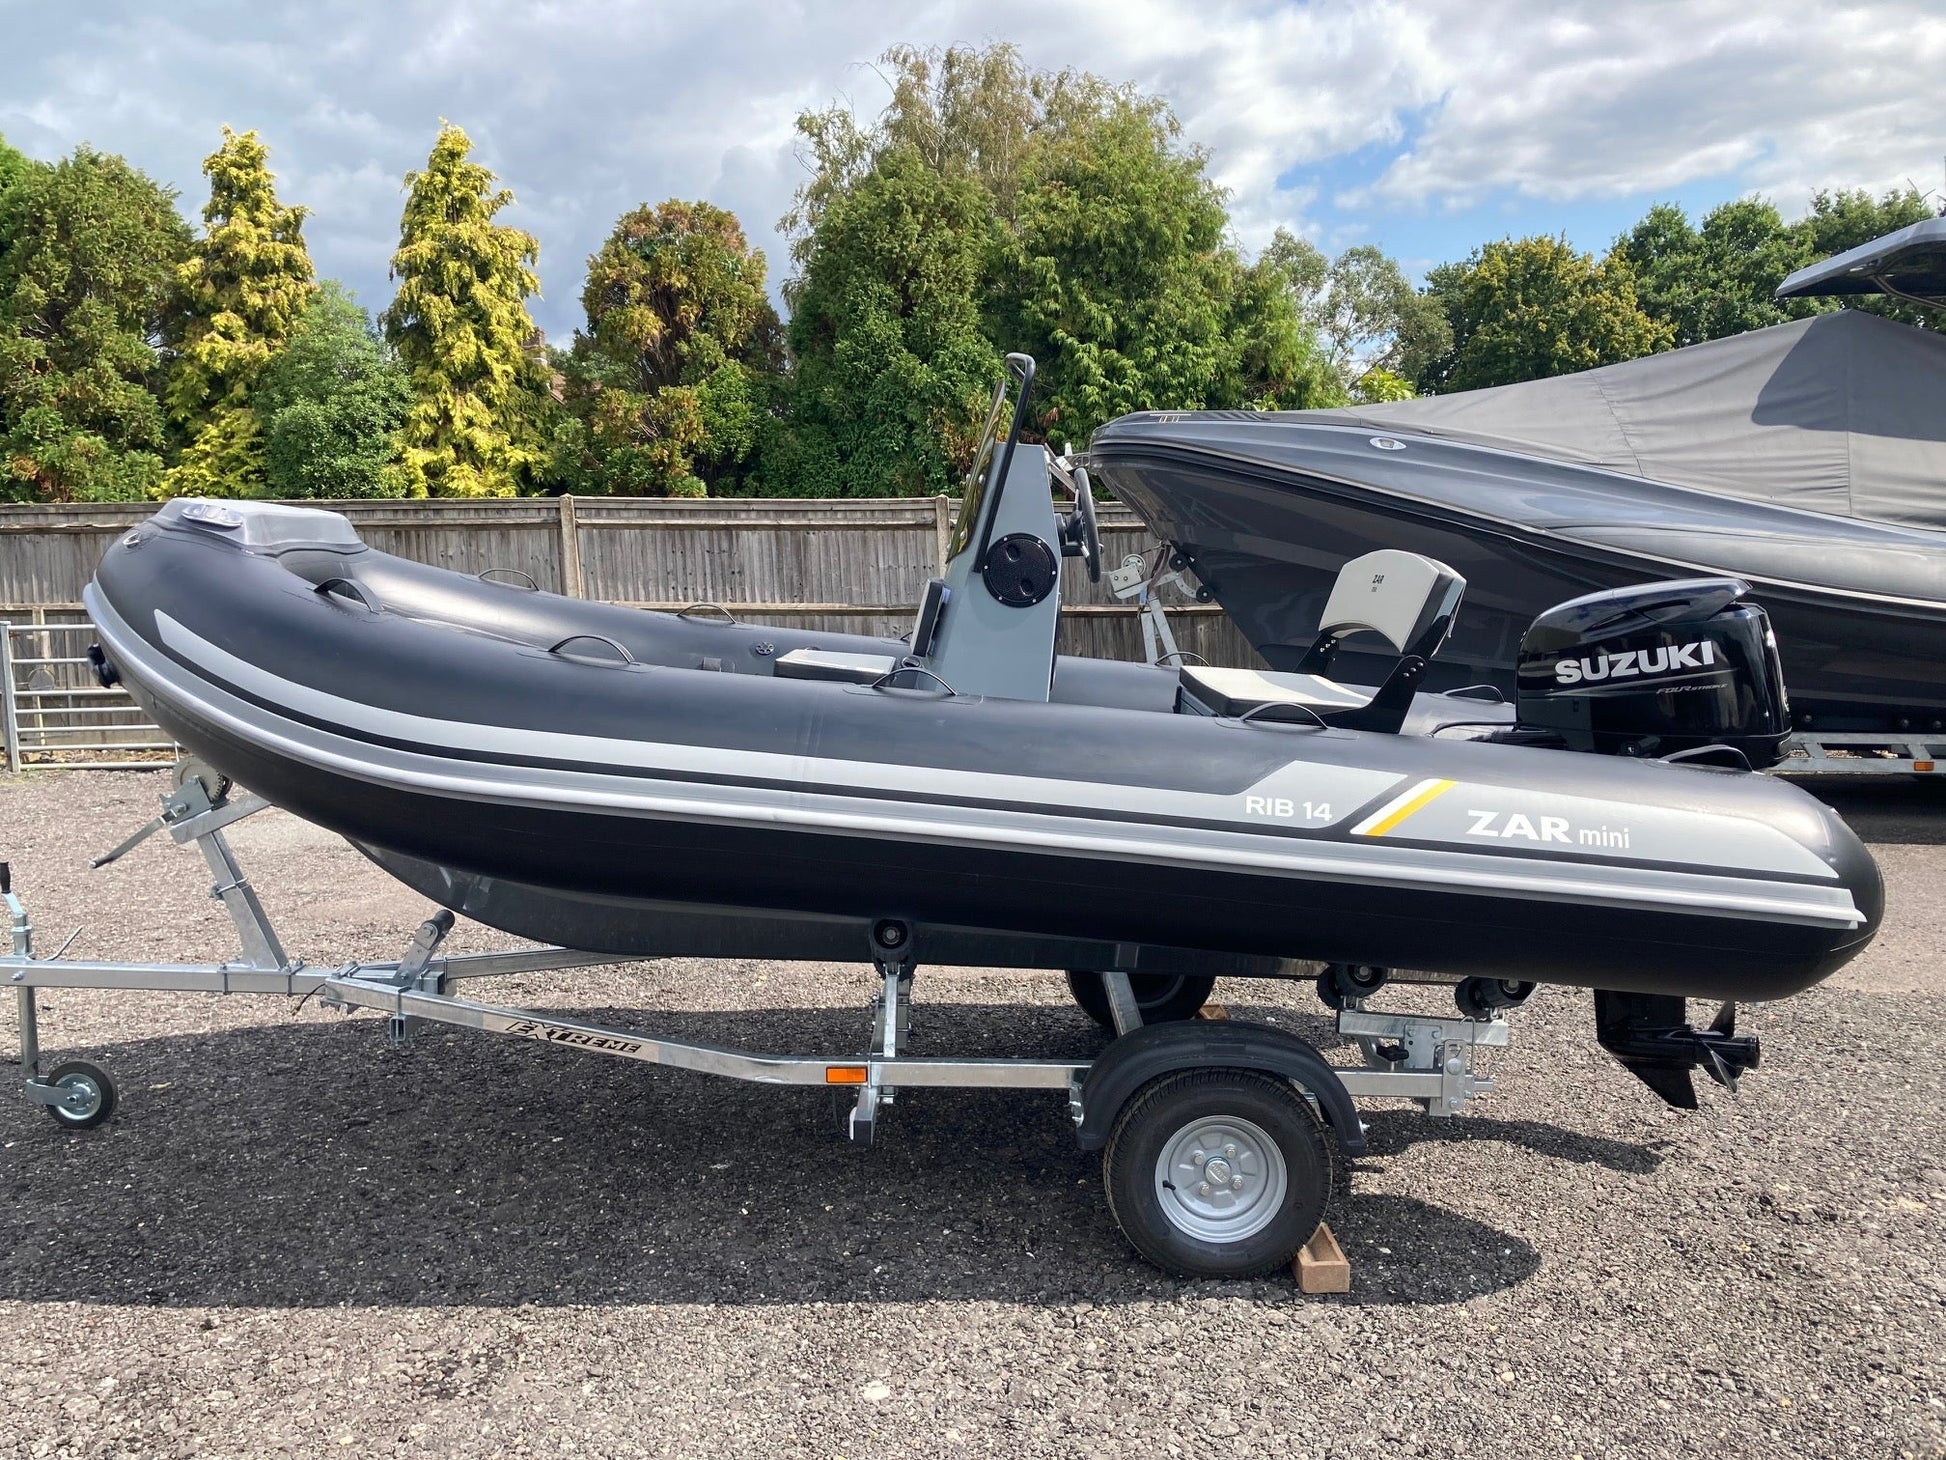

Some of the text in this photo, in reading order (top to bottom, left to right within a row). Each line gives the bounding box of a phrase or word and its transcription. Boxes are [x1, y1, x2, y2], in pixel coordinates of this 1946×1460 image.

[1555, 640, 1715, 684] SUZUKI
[1246, 795, 1333, 821] RIB 14
[1465, 809, 1630, 849] ZAR mini
[505, 1020, 642, 1054] EXTREME
